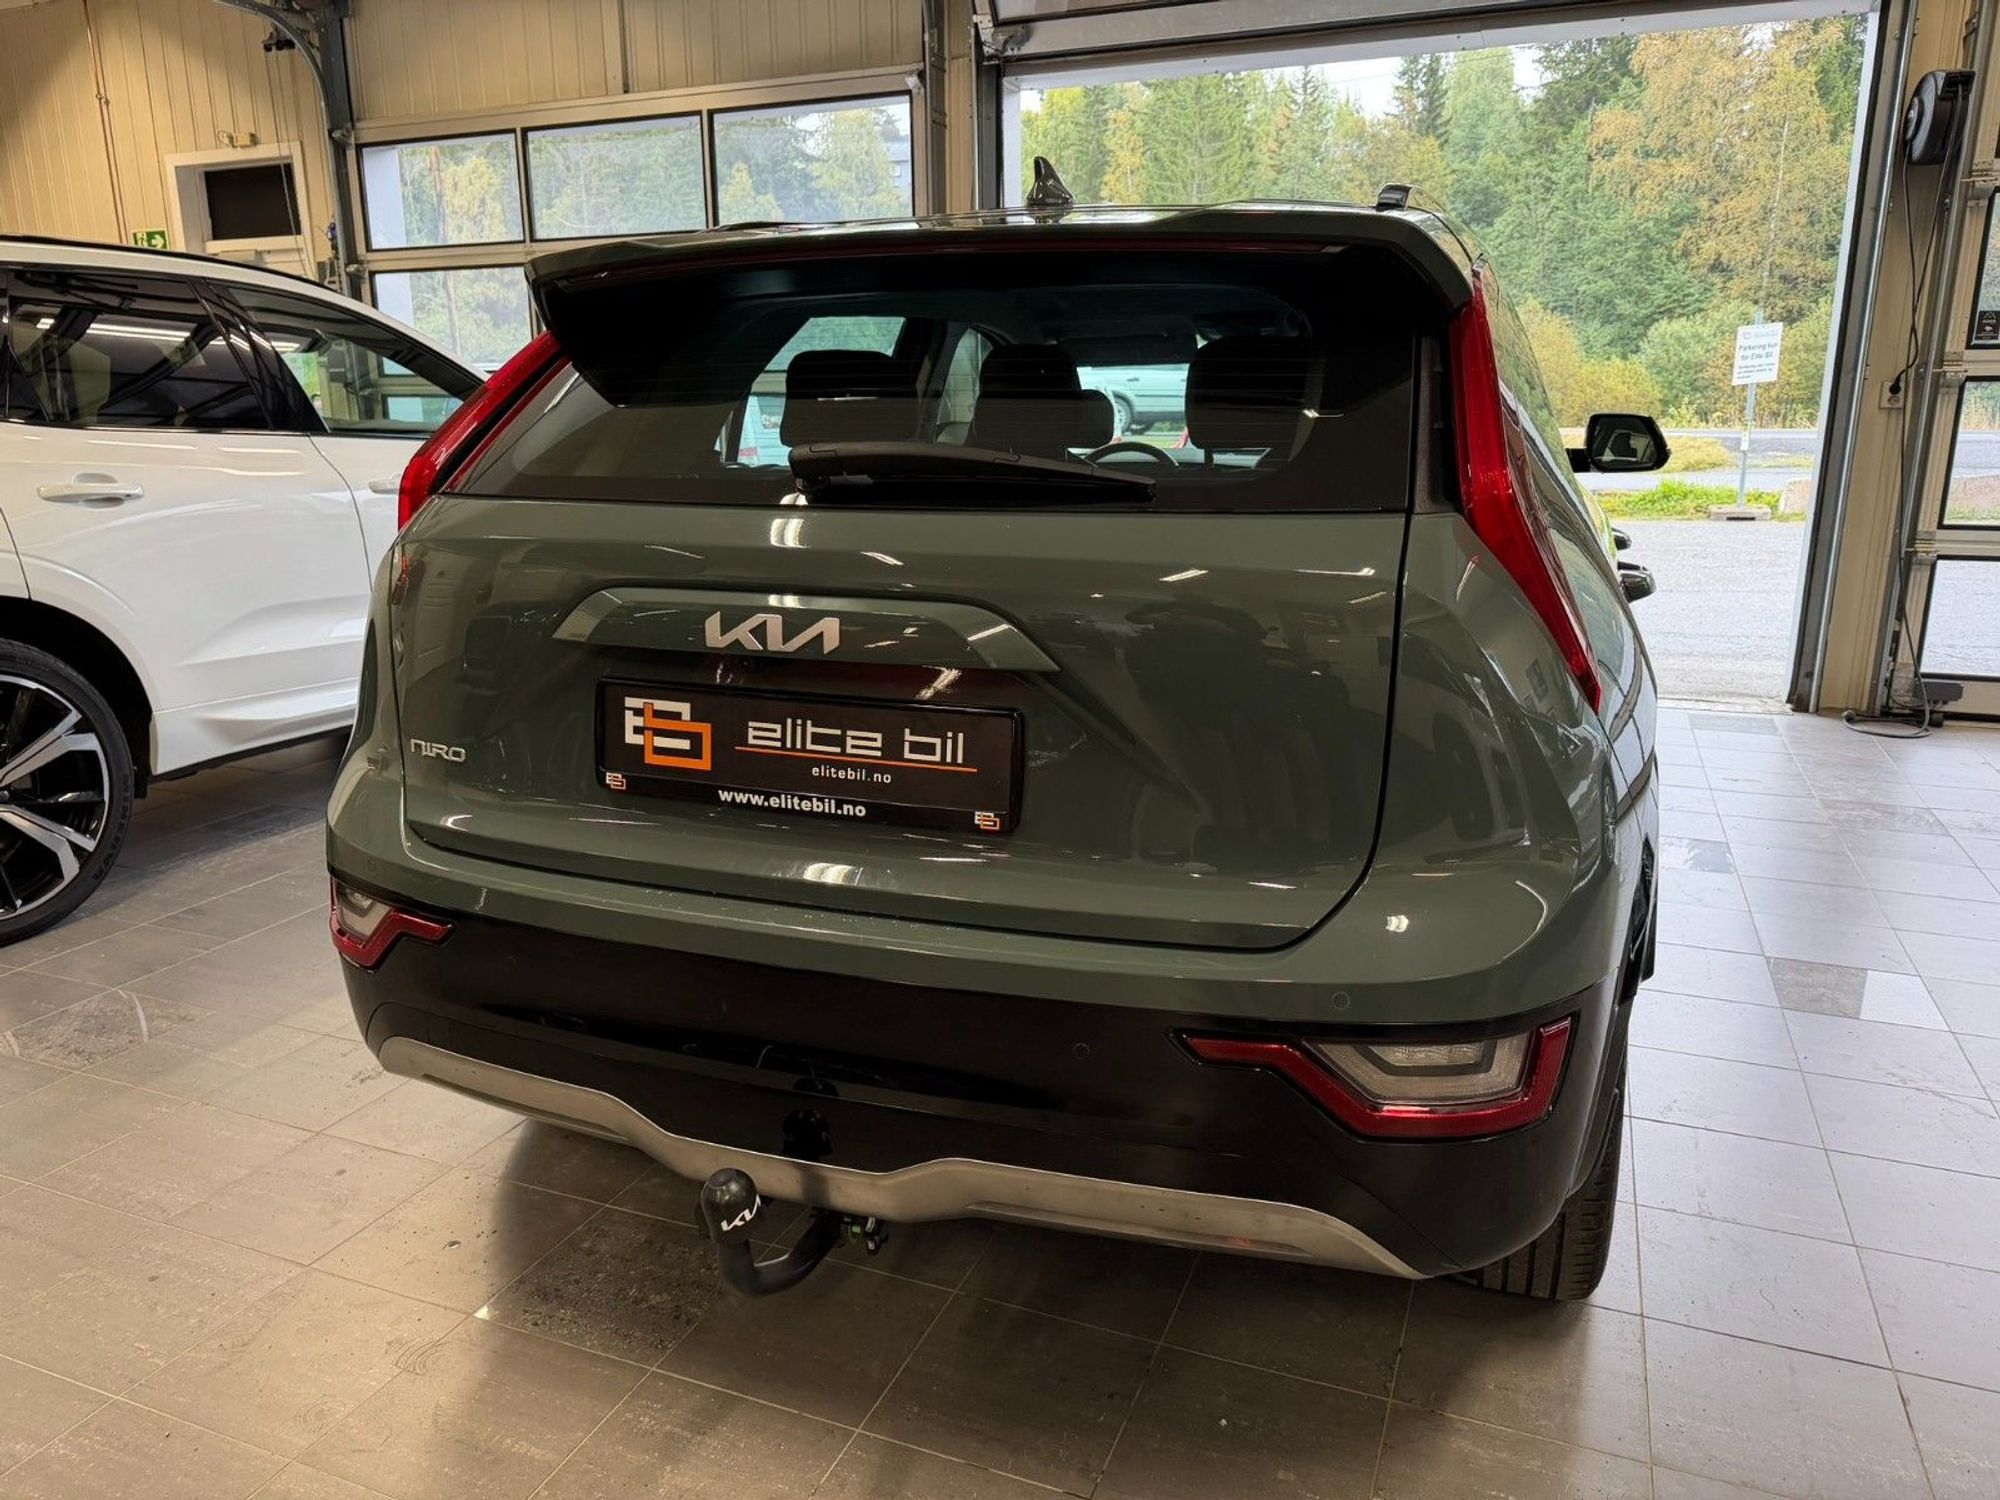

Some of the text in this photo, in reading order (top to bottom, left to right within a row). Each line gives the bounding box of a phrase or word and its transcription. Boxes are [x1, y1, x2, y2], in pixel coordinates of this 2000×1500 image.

[705, 610, 840, 655] KIA
[410, 738, 466, 763] NIRO
[747, 717, 964, 764] elite bil
[811, 764, 892, 784] elitebil.no
[717, 788, 867, 818] www.elitebil.no
